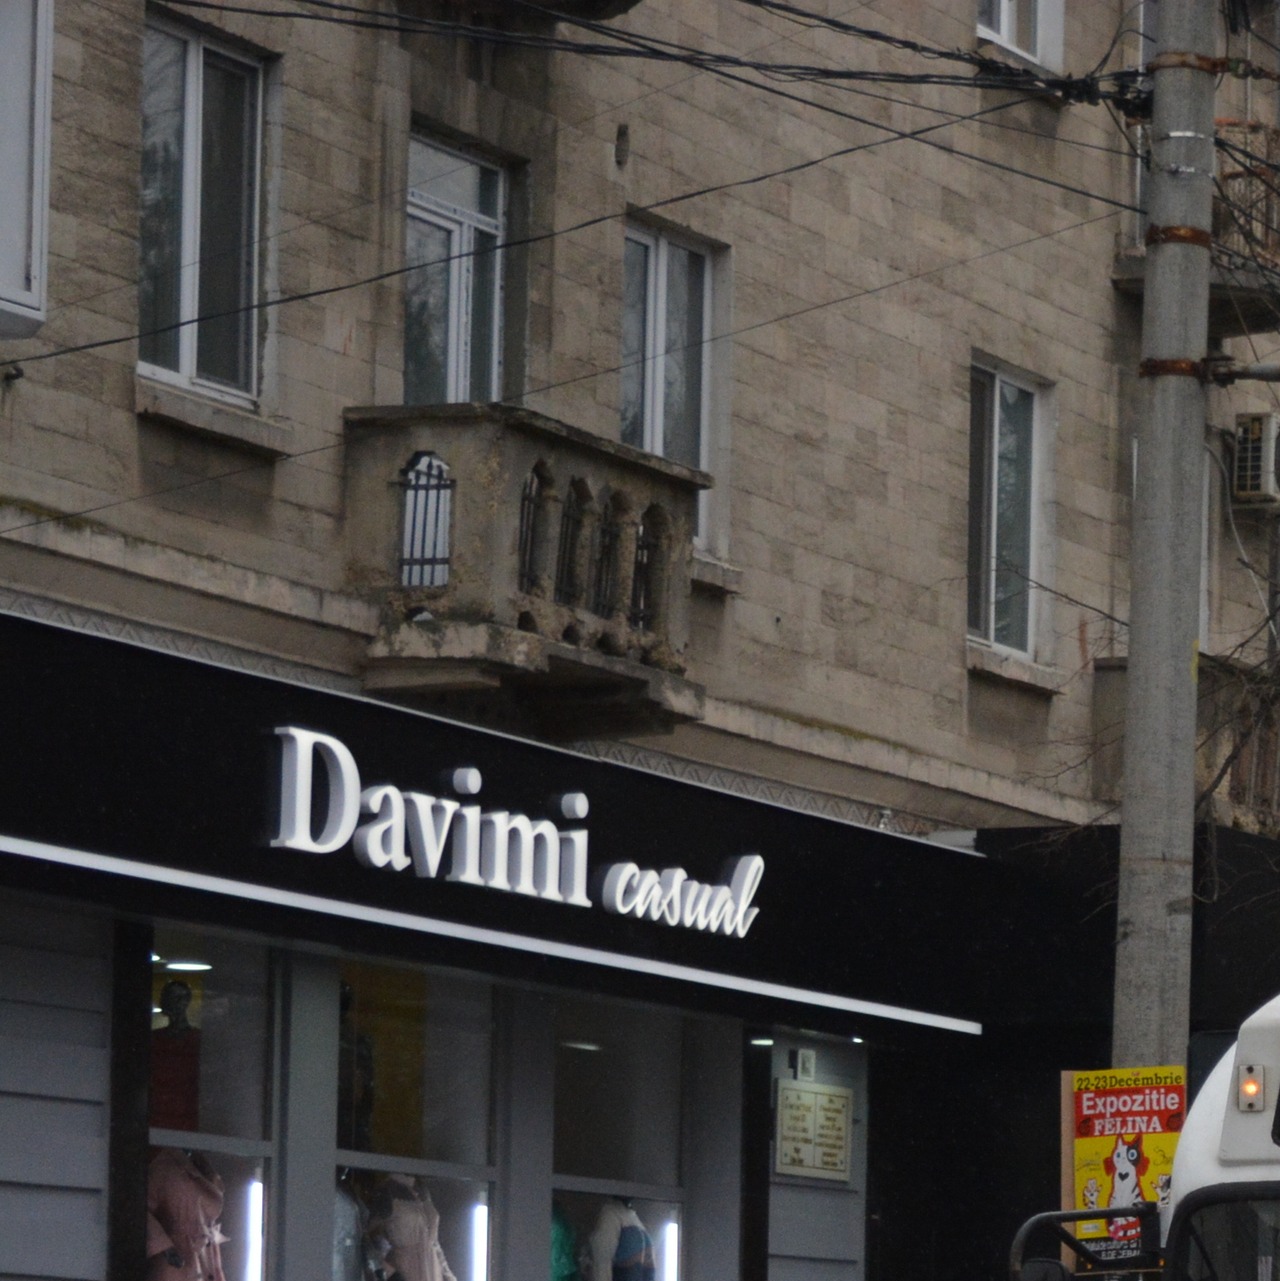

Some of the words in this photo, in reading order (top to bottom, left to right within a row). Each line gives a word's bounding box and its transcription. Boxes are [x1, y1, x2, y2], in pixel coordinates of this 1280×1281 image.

[270, 726, 592, 908] Davimi
[602, 854, 765, 938] casual
[1082, 1088, 1180, 1118] Expozitie
[1093, 1115, 1163, 1136] FELINA
